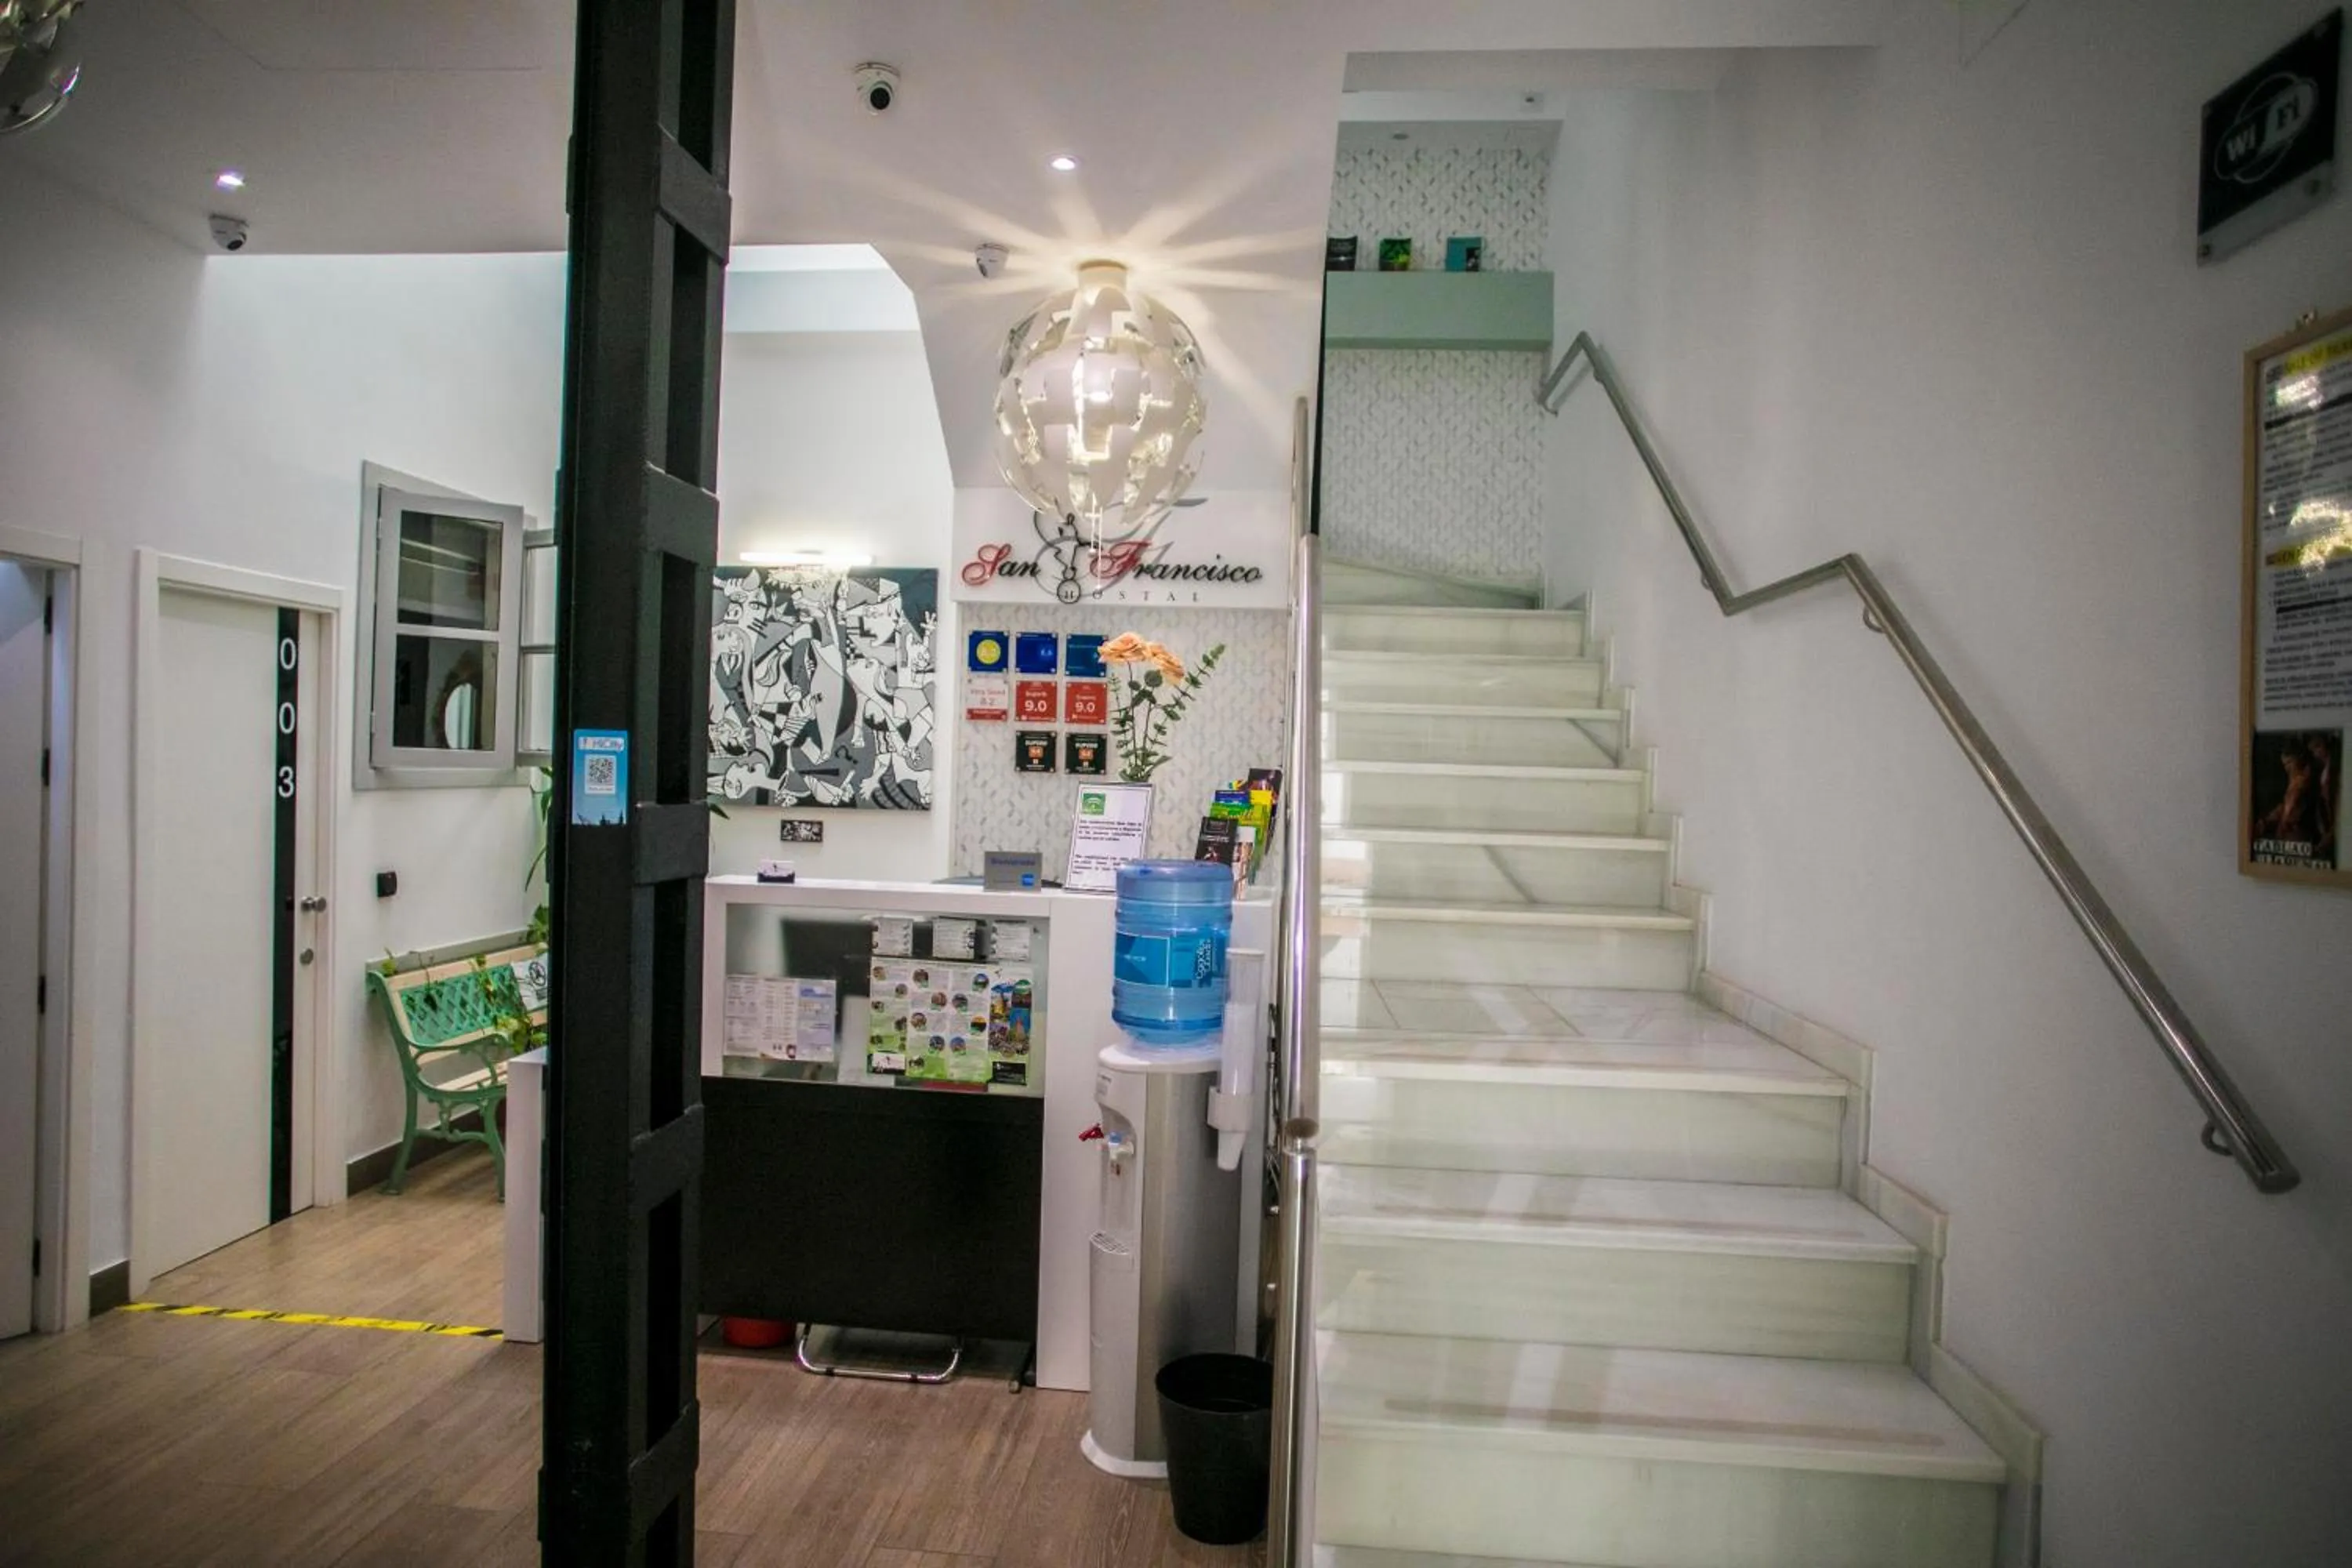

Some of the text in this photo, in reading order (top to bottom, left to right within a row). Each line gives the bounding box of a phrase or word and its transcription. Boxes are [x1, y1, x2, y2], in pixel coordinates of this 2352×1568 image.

[962, 540, 1263, 586] San Francisco
[1024, 699, 1047, 712] 9.0
[1075, 702, 1095, 712] 9.0
